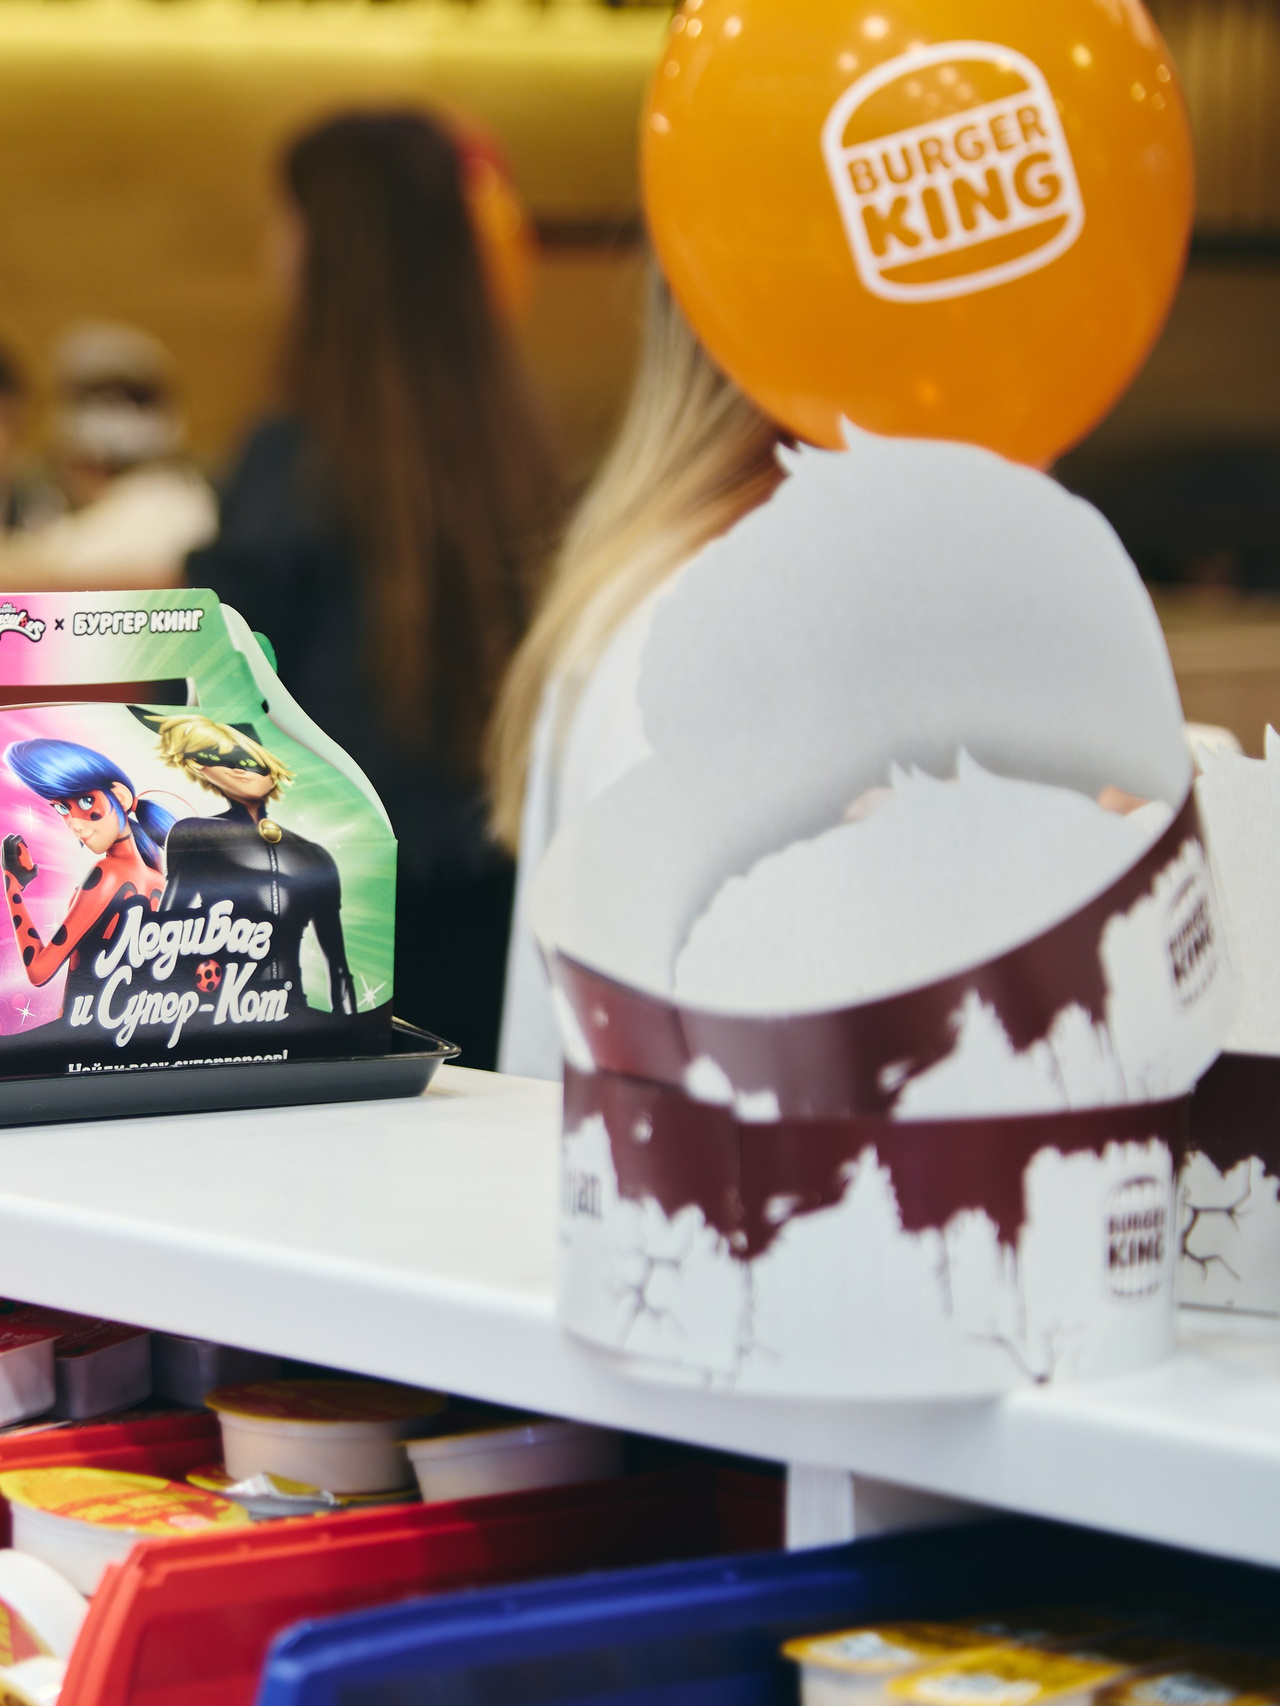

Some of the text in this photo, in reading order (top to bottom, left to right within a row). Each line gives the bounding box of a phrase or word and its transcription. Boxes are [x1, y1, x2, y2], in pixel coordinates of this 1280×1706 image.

[847, 104, 1047, 195] BURGER
[861, 151, 1063, 257] KING
[73, 608, 205, 636] БУРГЕР КИНГ
[70, 995, 95, 1027] и
